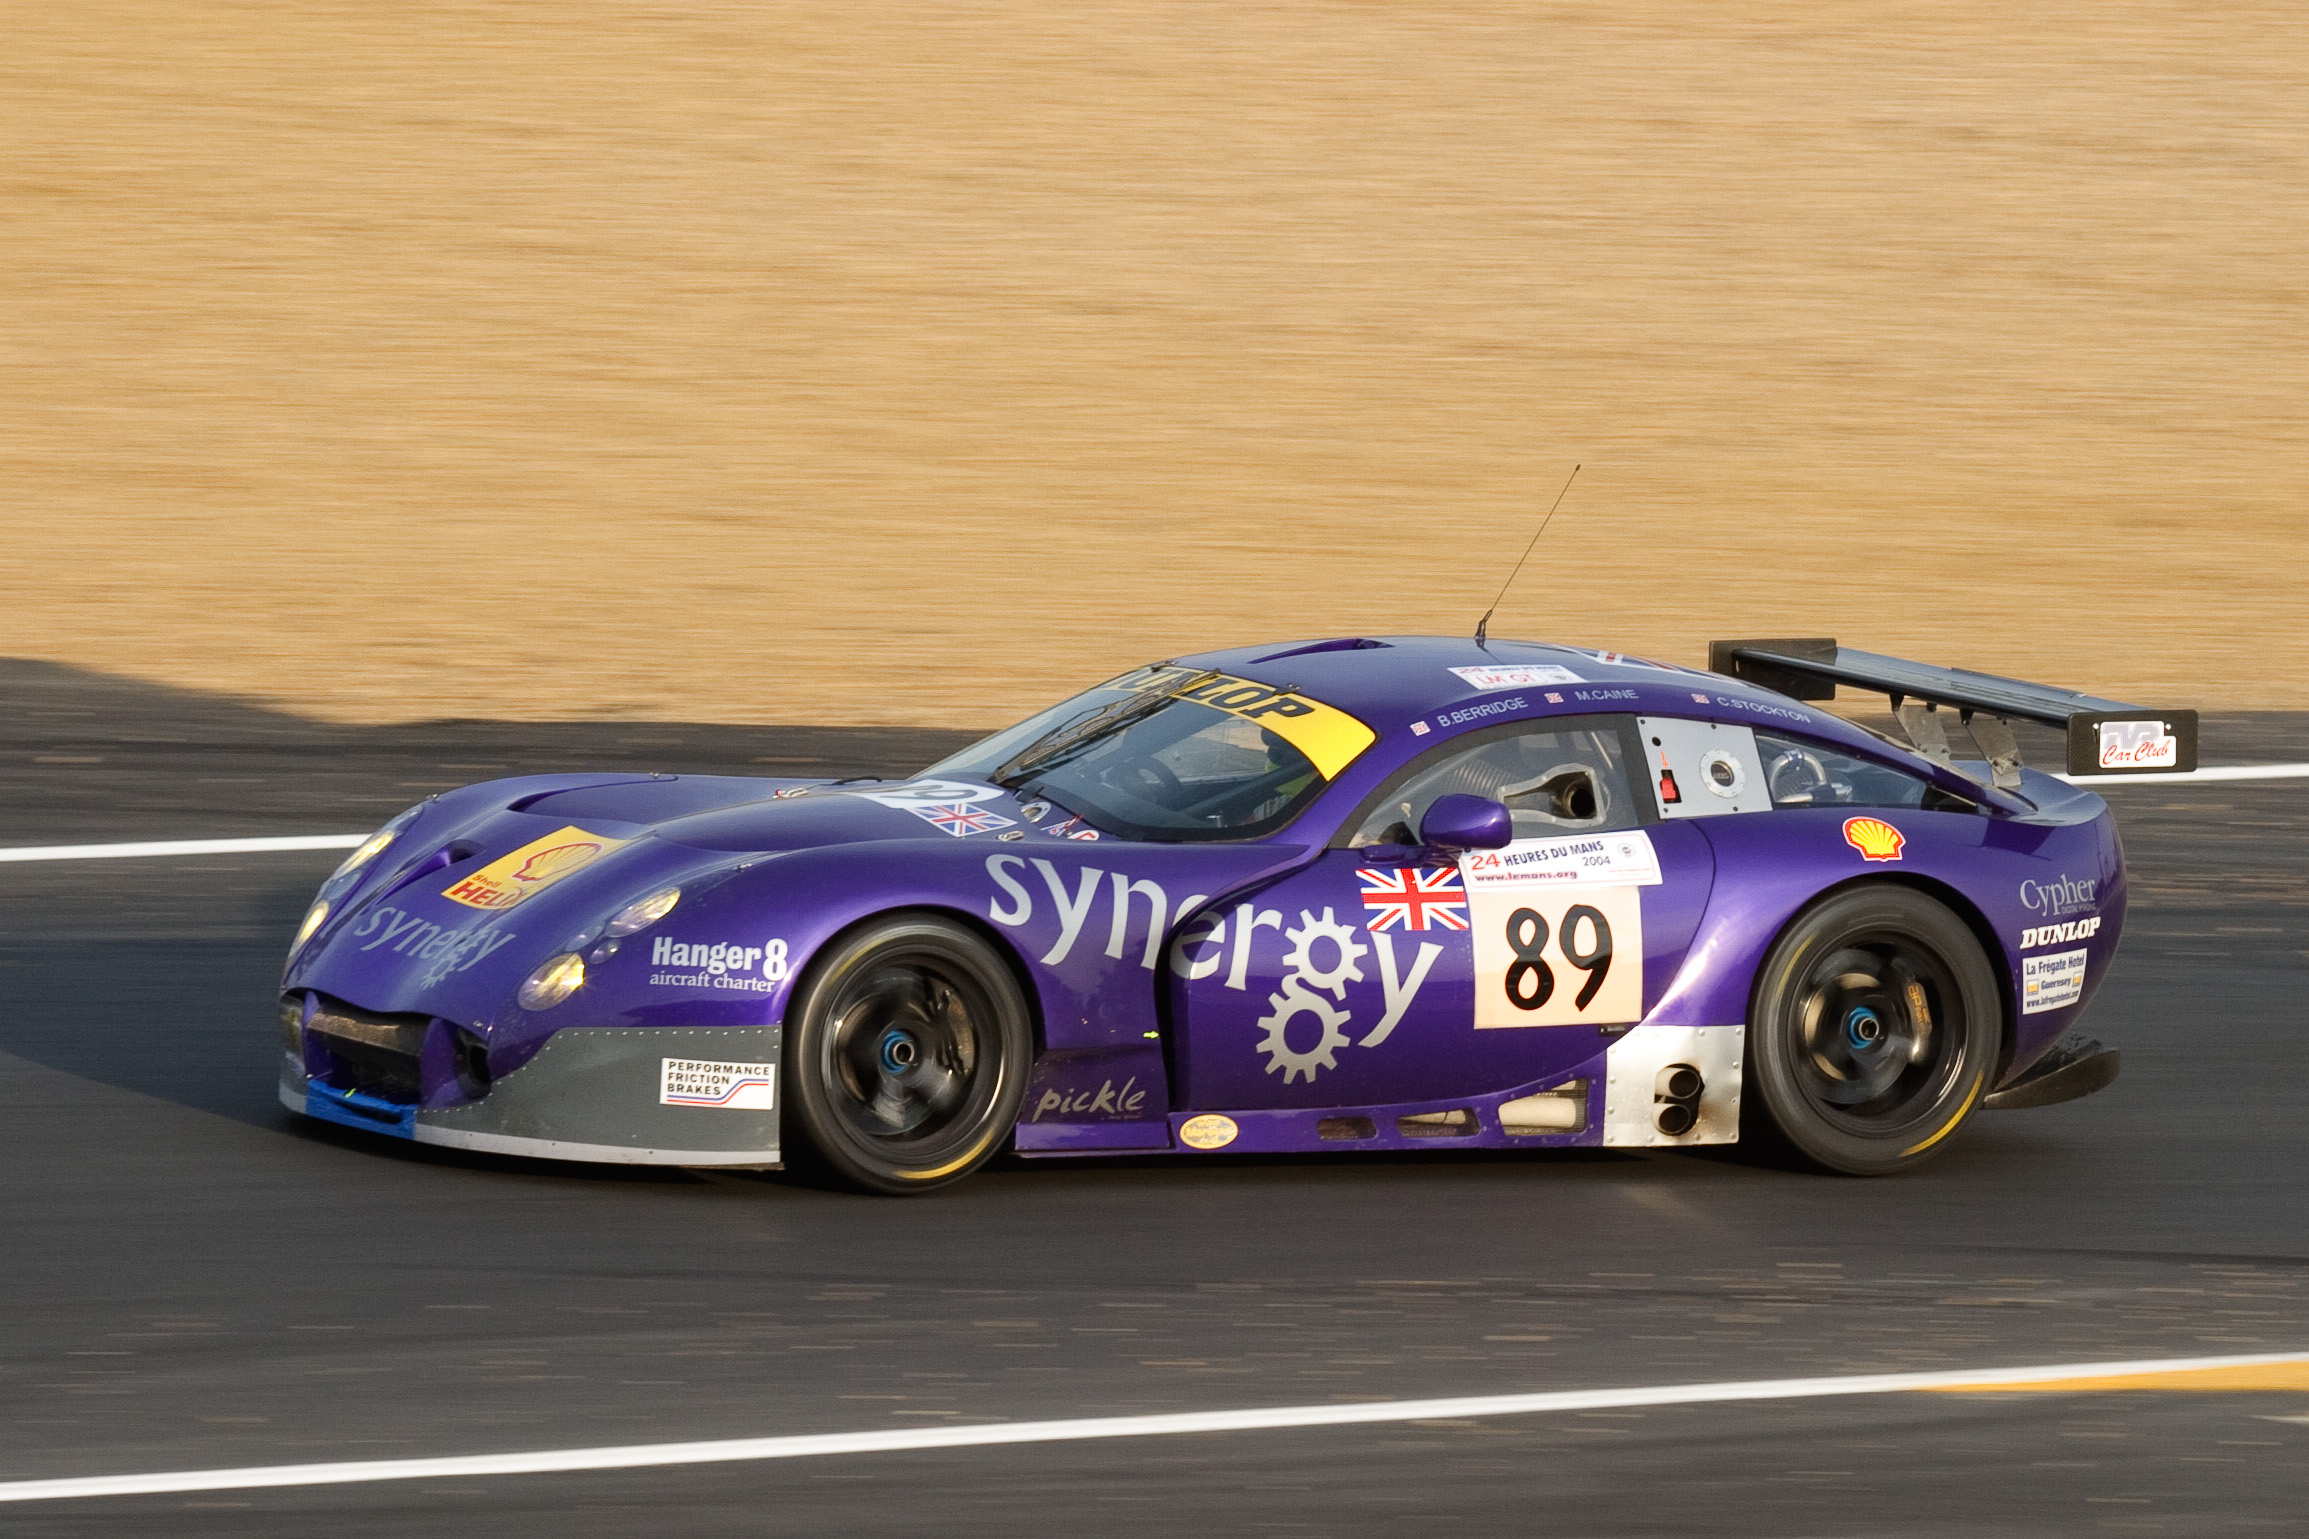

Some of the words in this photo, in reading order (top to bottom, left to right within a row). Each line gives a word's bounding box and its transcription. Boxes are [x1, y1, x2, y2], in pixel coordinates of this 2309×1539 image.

[1574, 689, 1640, 701] M.CAINE
[1436, 696, 1529, 728] B.BERRIDGE
[1716, 696, 1811, 724] C.STOCKTON
[2102, 744, 2131, 765] Car
[2134, 739, 2171, 762] Club
[1470, 853, 1501, 870] 24
[1503, 848, 1549, 867] HEURES
[1550, 845, 1568, 859] DU
[1570, 840, 1604, 855] MANS
[1582, 855, 1611, 867] 2004
[473, 874, 503, 888] Shell
[1474, 870, 1578, 883] www.lemans.org
[2020, 873, 2096, 917] Cypher
[2020, 916, 2101, 949] DUNLOP
[651, 937, 762, 975] Hanger
[762, 938, 788, 981] 8
[1504, 904, 1613, 1012] 89
[2026, 963, 2036, 975] La
[649, 970, 710, 987] aircraft
[713, 973, 776, 993] charter
[668, 1061, 770, 1076] PERFORMANCE
[668, 1072, 730, 1085] FRICTION
[667, 1083, 721, 1095] BRAKES
[1032, 1076, 1146, 1122] pickle
